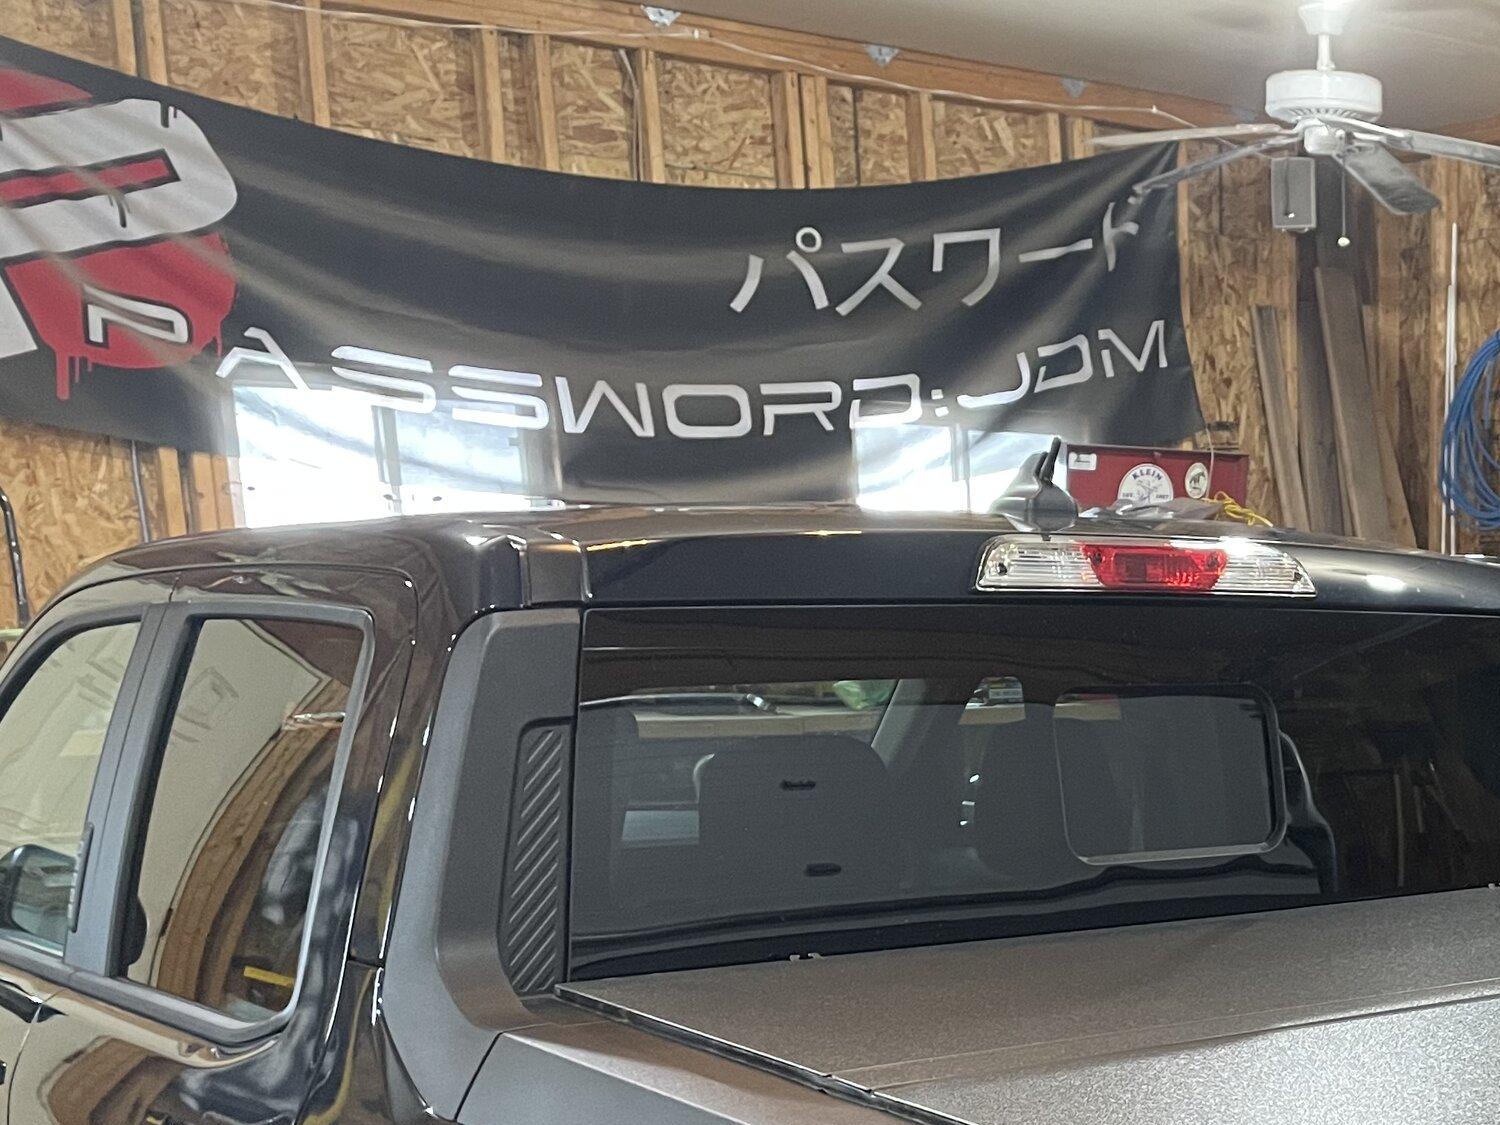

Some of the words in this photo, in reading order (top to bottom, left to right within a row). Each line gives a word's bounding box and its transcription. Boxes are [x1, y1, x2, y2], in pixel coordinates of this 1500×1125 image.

[730, 187, 1142, 316] パスワード
[1132, 468, 1163, 481] KLEIN
